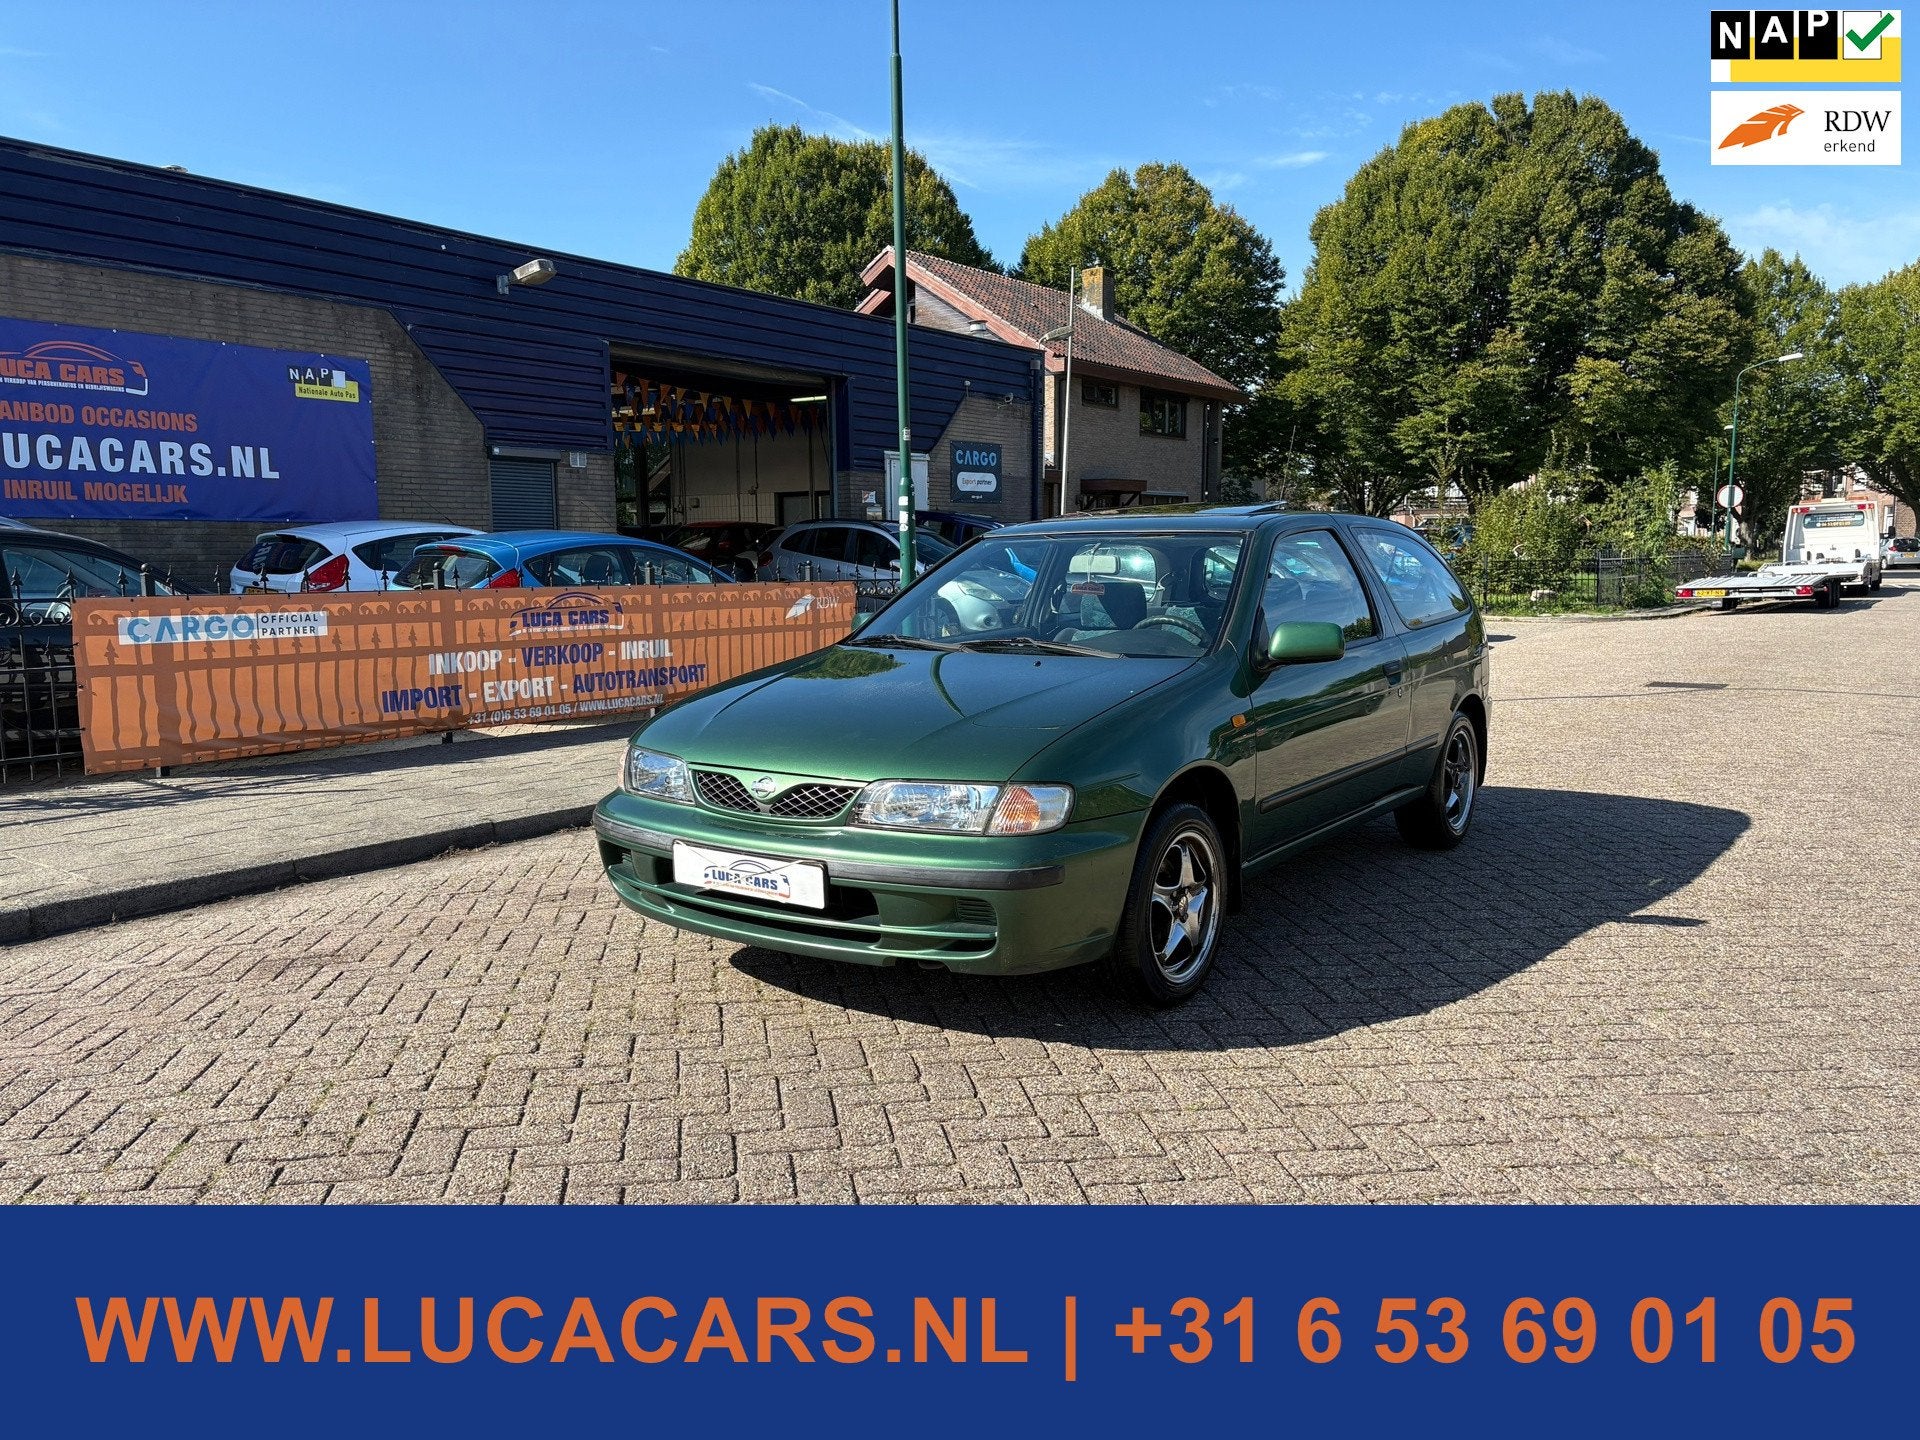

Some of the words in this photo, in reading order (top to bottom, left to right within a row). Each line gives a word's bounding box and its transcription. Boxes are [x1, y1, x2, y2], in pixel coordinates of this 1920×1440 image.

[59, 363, 125, 386] CARS
[289, 368, 329, 380] NAP
[298, 386, 329, 397] Nationale
[329, 389, 344, 398] Auto
[345, 391, 356, 399] Pas
[81, 406, 198, 433] OCCASIONS
[955, 449, 997, 467] CARGO
[3, 479, 78, 501] INRUIL
[83, 482, 189, 504] MOGELIJK
[816, 596, 840, 609] RDW
[127, 614, 255, 643] CARGO
[260, 613, 319, 625] OFFICIAL
[521, 611, 563, 628] LUCA
[567, 609, 610, 626] CARS
[261, 625, 316, 636] PARTNER
[428, 650, 503, 675] INKOOP
[521, 642, 604, 668] VERKOOP
[620, 639, 674, 660] INRUIL
[381, 684, 463, 713] IMPORT
[483, 677, 555, 703] EXPORT
[572, 664, 707, 694] AUTOTRANSPORT
[467, 712, 487, 725] +31
[490, 709, 511, 724] (0)6
[513, 708, 527, 720] 53
[529, 706, 542, 718] 69
[544, 705, 556, 717] 01
[559, 703, 571, 715] 05
[580, 693, 665, 712] WWW.LUCACARS.NL
[712, 869, 742, 885] LUCA
[745, 874, 778, 891] CARS
